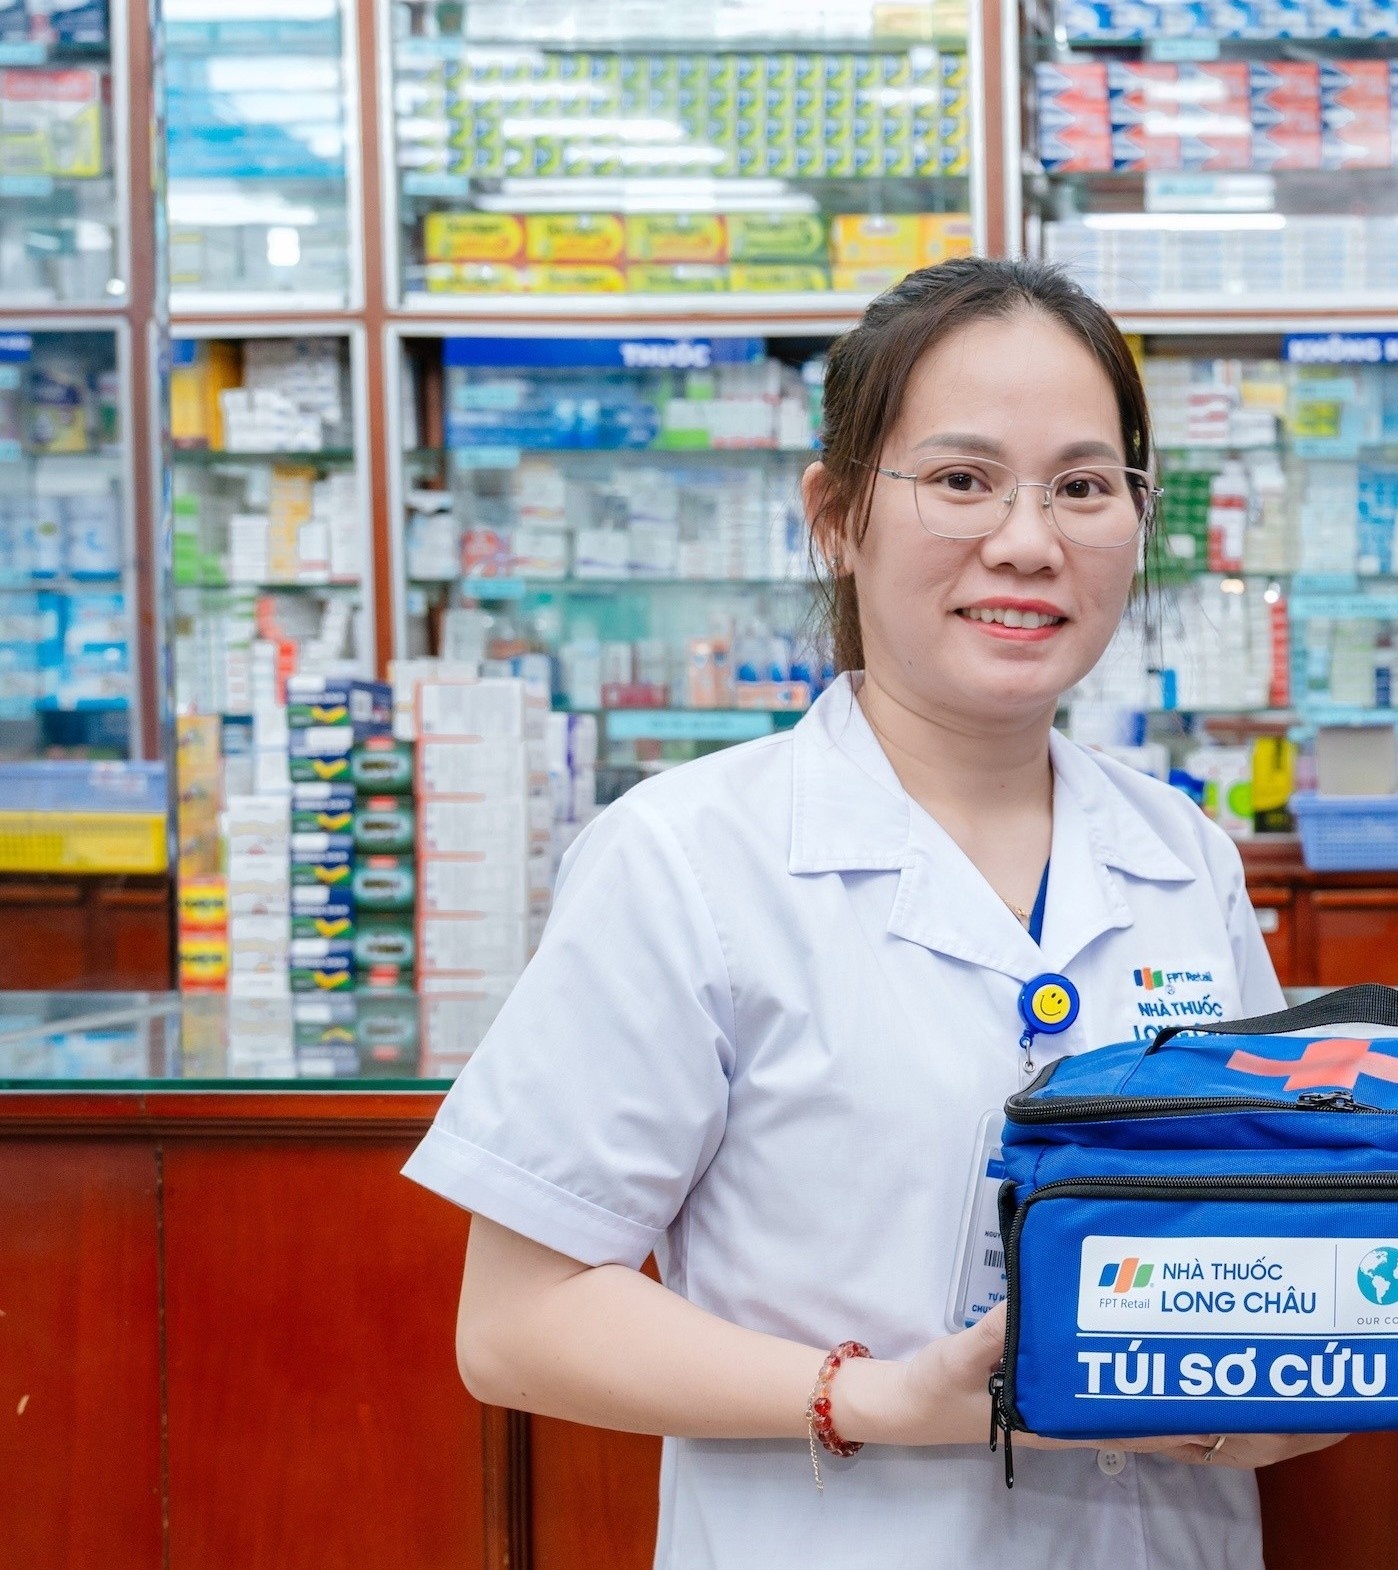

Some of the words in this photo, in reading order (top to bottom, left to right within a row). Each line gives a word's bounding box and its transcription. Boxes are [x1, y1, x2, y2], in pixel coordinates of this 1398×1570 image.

[619, 338, 711, 368] THUỐC
[1288, 333, 1382, 362] KHÔNG
[1166, 971, 1184, 983] FPT
[1137, 998, 1171, 1017] NHÀ
[1171, 994, 1223, 1017] THUỐC
[985, 1230, 1001, 1239] NGUY
[1163, 1258, 1204, 1280] NHÀ
[1211, 1256, 1283, 1281] THUỐC
[1099, 1298, 1117, 1308] FPT
[1121, 1298, 1150, 1309] Retail
[1161, 1290, 1236, 1313] LONG
[1243, 1285, 1316, 1314] CHÂU
[1357, 1316, 1380, 1325] OUR
[1077, 1340, 1165, 1395] TÚI
[1179, 1348, 1256, 1396] SƠ
[1269, 1341, 1387, 1397] CỨU
